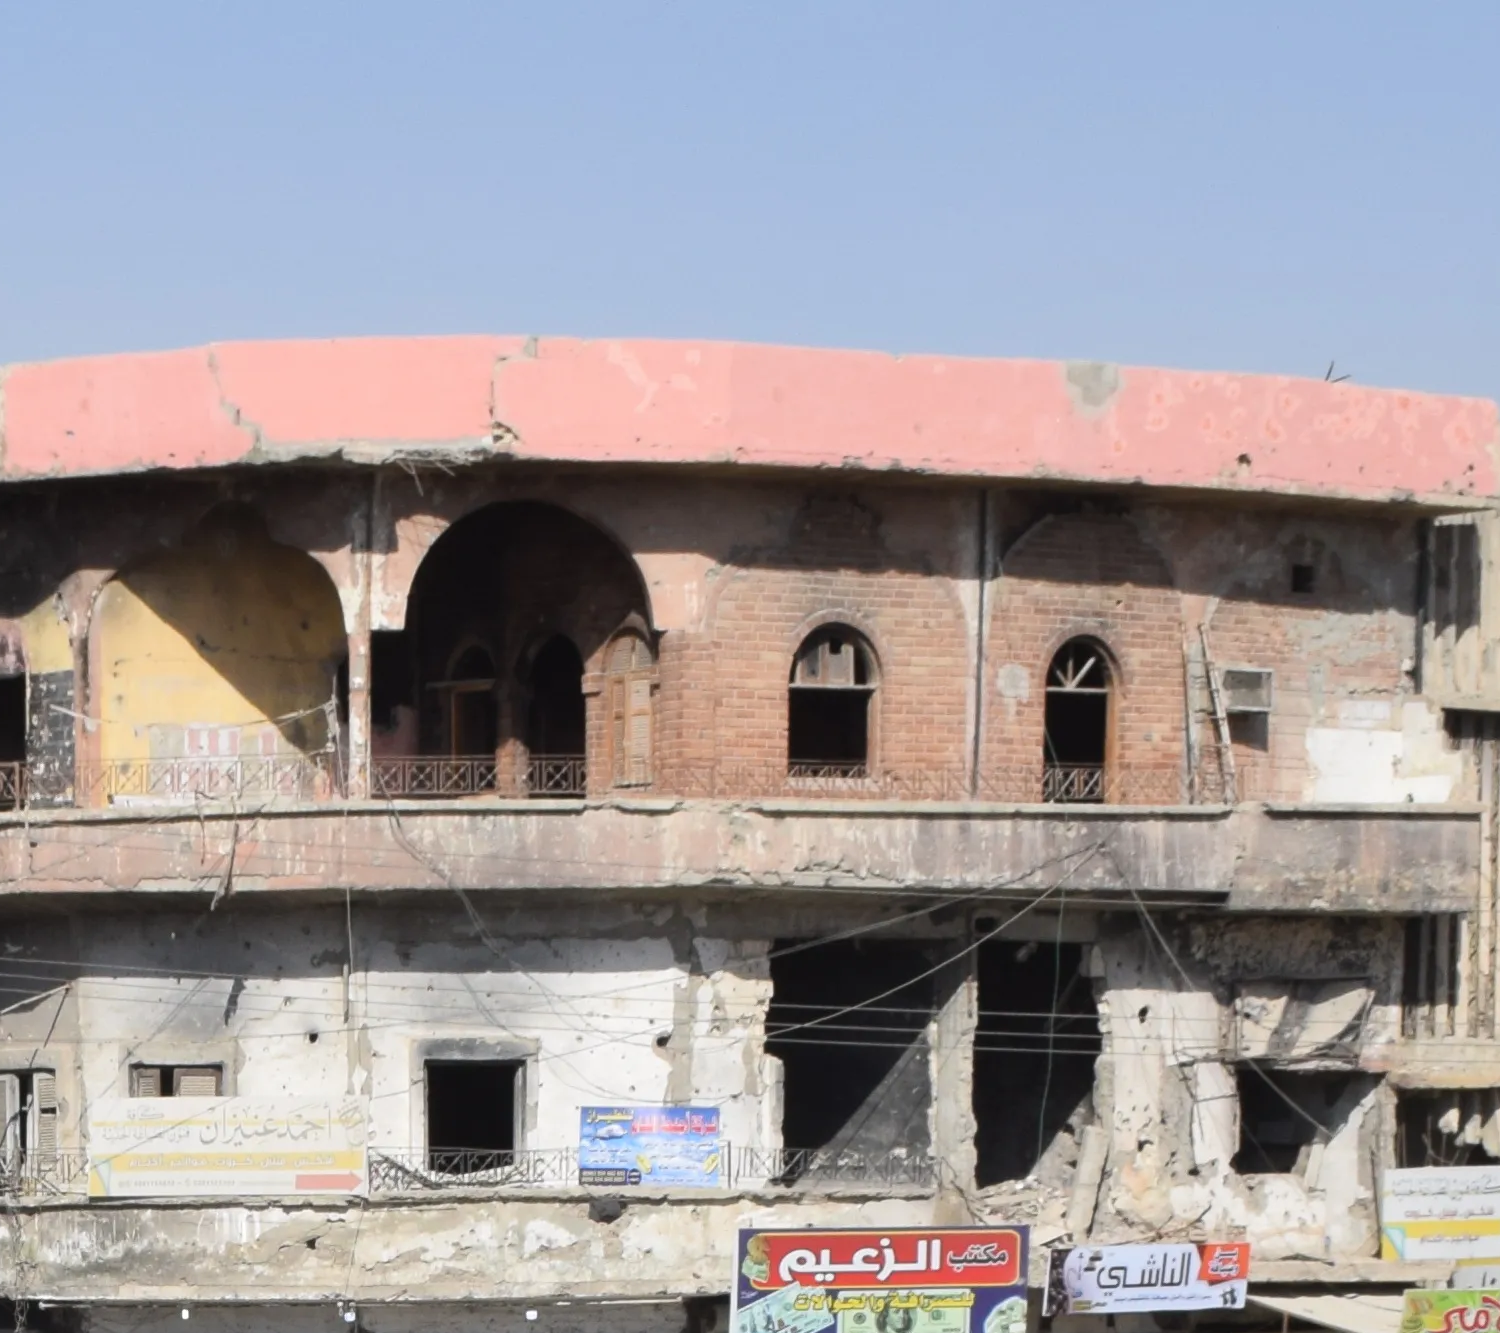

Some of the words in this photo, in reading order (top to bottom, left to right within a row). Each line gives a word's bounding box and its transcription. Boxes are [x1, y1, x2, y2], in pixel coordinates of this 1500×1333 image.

[778, 1237, 942, 1282] الزعيم
[947, 1243, 1009, 1273] مكتب
[793, 1291, 890, 1313] والحوالات
[890, 1290, 976, 1311] للصرافة
